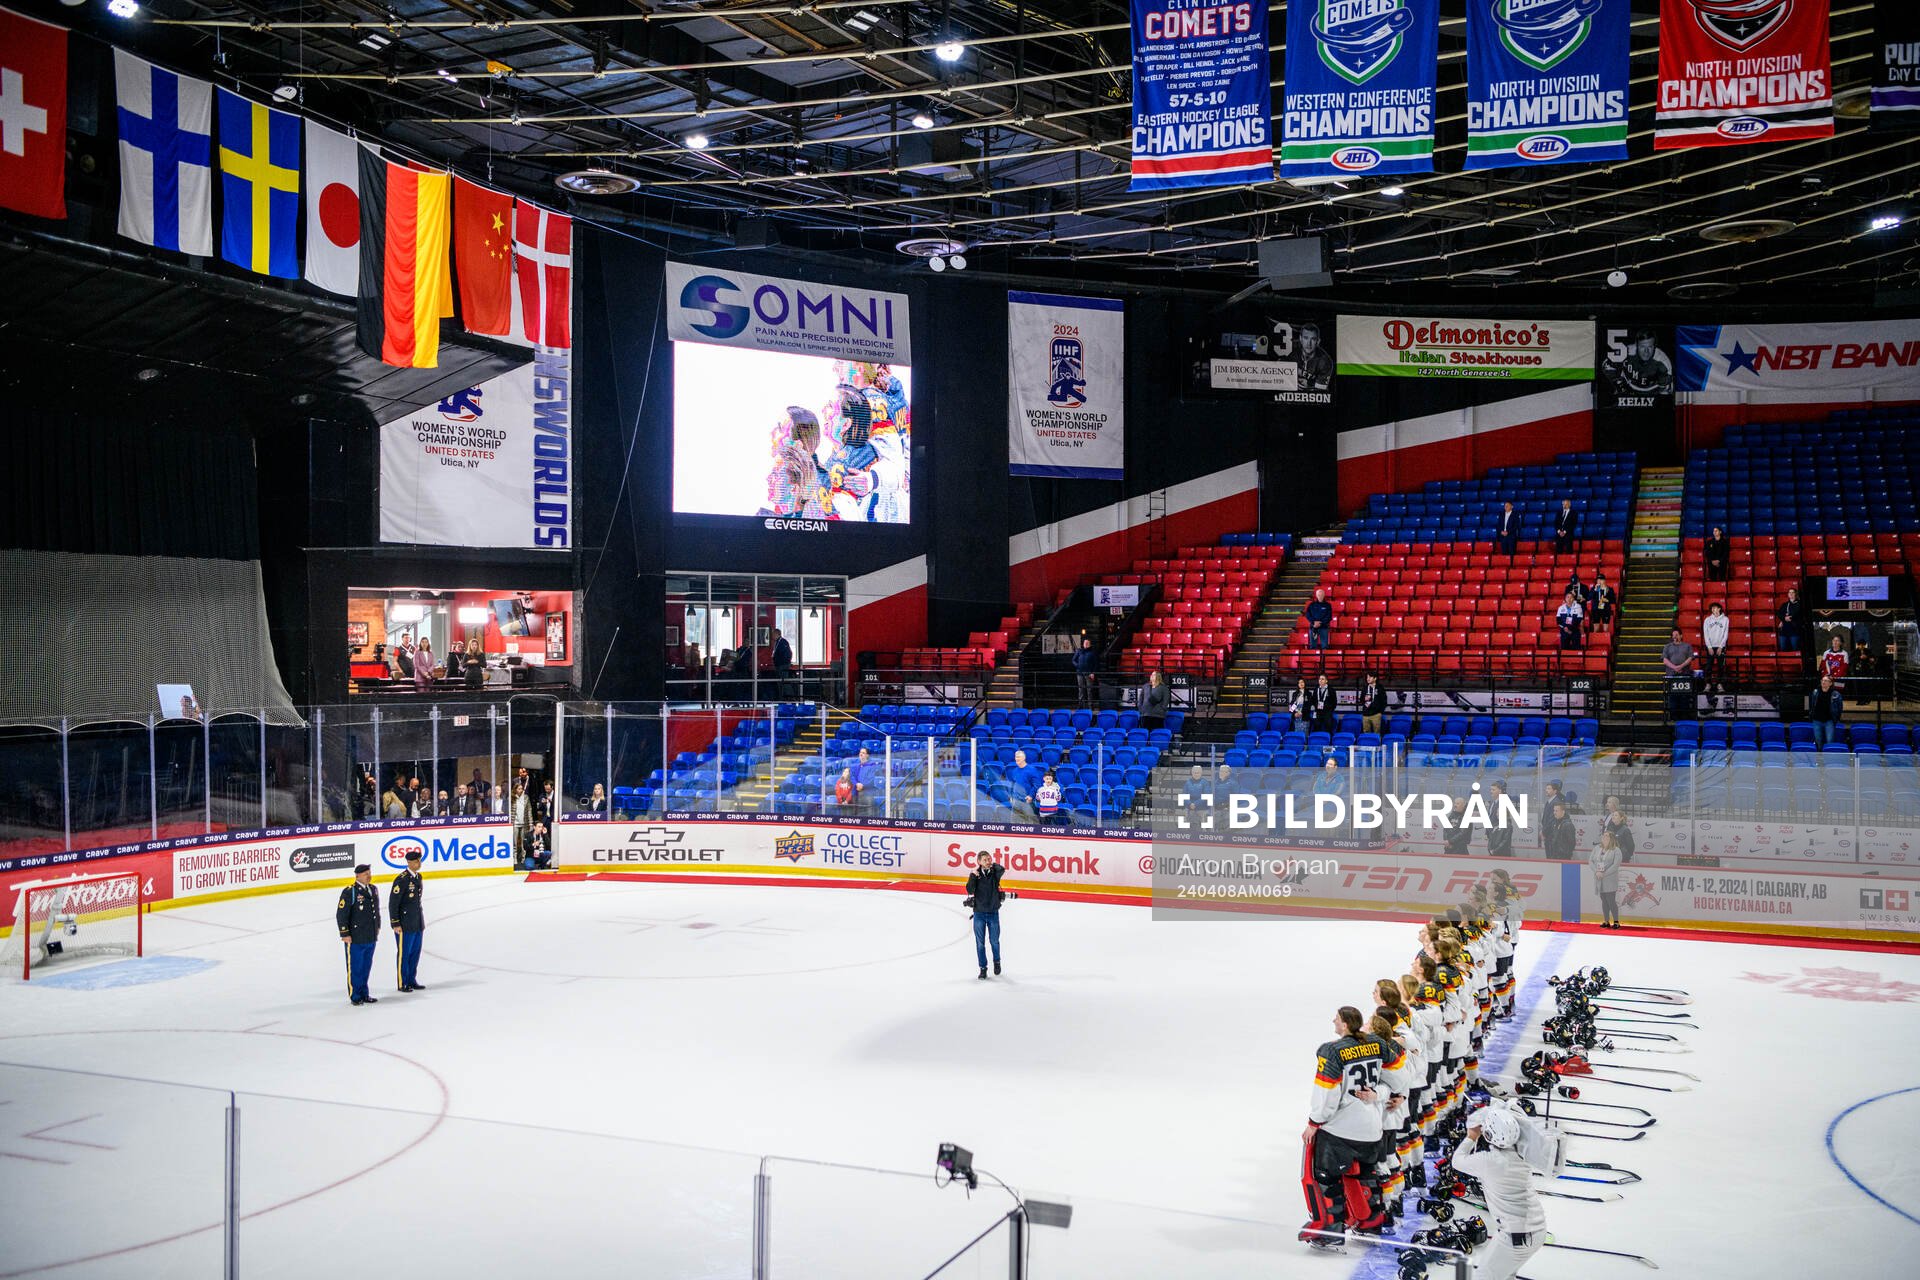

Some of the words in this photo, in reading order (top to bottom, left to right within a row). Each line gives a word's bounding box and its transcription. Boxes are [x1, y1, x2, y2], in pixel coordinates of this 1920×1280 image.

[1145, 3, 1251, 40] COMETS
[1686, 60, 1731, 79] NORTH
[1737, 53, 1802, 76] DIVISION
[1889, 67, 1911, 82] CNY
[1490, 80, 1535, 99] NORTH
[1540, 74, 1600, 95] DIVISION
[1661, 69, 1826, 109] CHAMPIONS
[1169, 91, 1226, 108] 57-5-10
[1286, 92, 1345, 110] WESTERN
[1349, 87, 1432, 108] CONFERENCE
[1138, 112, 1179, 126] EASTERN
[1182, 109, 1221, 123] HOCKEY
[1224, 103, 1260, 119] LEAGUE
[1468, 90, 1624, 129] CHAMPIONS
[1284, 105, 1430, 139] CHAMPIONS
[1730, 122, 1760, 133] AHL
[1132, 117, 1265, 153] CHAMPIONS
[1528, 141, 1560, 153] AHL
[1342, 152, 1371, 164] AHL
[755, 327, 779, 338] PAIN
[780, 331, 801, 342] AND
[802, 333, 849, 346] PRECISION
[852, 339, 895, 350] MEDICINE
[1053, 325, 1080, 336] 2024
[1273, 322, 1293, 357] 3
[1382, 320, 1551, 350] Delmonico's
[1054, 345, 1080, 356] IIHF
[1606, 329, 1628, 363] 5
[1399, 351, 1447, 365] Italian
[1449, 352, 1543, 366] Steakhouse
[1753, 344, 1833, 371] NBT
[1214, 365, 1228, 375] JIM
[1230, 366, 1258, 375] BROCK
[1260, 367, 1296, 376] AGENCY
[1418, 368, 1433, 377] 147
[1434, 368, 1460, 377] North
[1462, 368, 1499, 378] Genesee
[1500, 369, 1512, 378] St.
[1617, 397, 1655, 407] KELLY
[1026, 409, 1070, 421] WOMEN'S
[1073, 412, 1108, 423] WORLD
[1031, 419, 1104, 431] CHAMPIONSHIP
[412, 421, 466, 437] WOMEN'S
[467, 428, 508, 441] WORLD
[1036, 429, 1066, 439] UNITED
[1067, 431, 1098, 441] STATES
[418, 432, 503, 450] CHAMPIONSHIP
[1050, 438, 1073, 449] Utica,
[1074, 439, 1085, 448] NY
[425, 445, 459, 458] UNITED
[460, 448, 496, 461] STATES
[440, 458, 467, 469] Utica,
[468, 461, 481, 469] NY
[865, 674, 879, 682] 101
[1249, 678, 1265, 686] 102
[1571, 681, 1590, 689] 102
[1671, 682, 1690, 690] 103
[827, 833, 902, 851] COLLECT
[179, 852, 230, 874] REMOVING
[233, 847, 281, 866] BARRIERS
[592, 849, 725, 861] CHEVROLET
[821, 848, 855, 864] THE
[857, 852, 905, 867] BEST
[181, 875, 194, 892] TO
[196, 872, 227, 889] GROW
[229, 868, 247, 885] THE
[250, 865, 280, 882] GAME
[1338, 864, 1433, 892] TSN
[1661, 875, 1685, 892] MAY
[1687, 877, 1695, 892] 4
[1703, 878, 1718, 897] 12,
[1719, 879, 1748, 896] 2024
[1756, 880, 1810, 900] CALGARY,
[1812, 883, 1828, 900] AB
[1860, 914, 1901, 923] SWISS
[1340, 1043, 1381, 1062] ABSTREITER
[1349, 1061, 1378, 1098] 35
